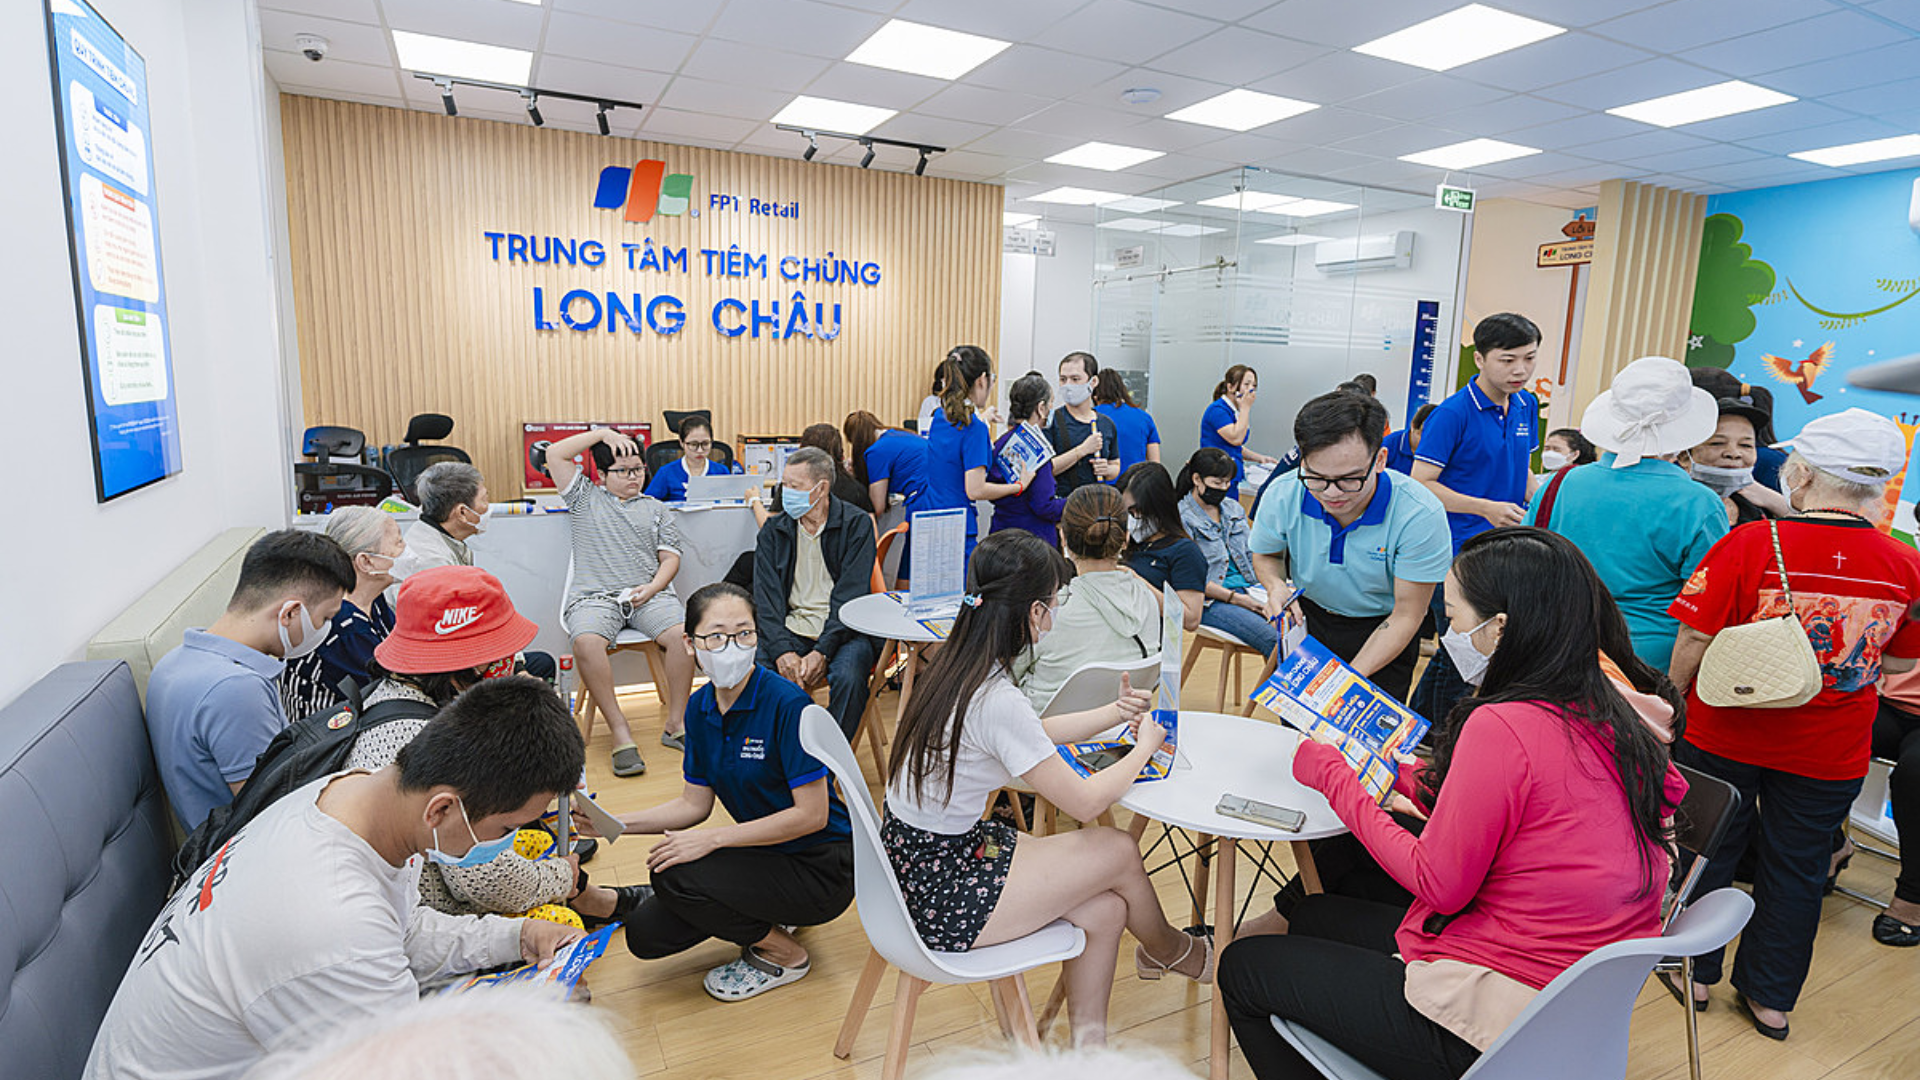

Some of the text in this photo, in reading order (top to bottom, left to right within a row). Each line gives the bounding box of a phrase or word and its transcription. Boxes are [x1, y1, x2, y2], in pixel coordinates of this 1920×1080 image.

[710, 193, 799, 219] FPT Retail
[484, 231, 881, 285] TRUNG TÂM TIÊM CHỦNG
[534, 287, 841, 340] LONG CHÂU
[442, 606, 477, 625] NIKE
